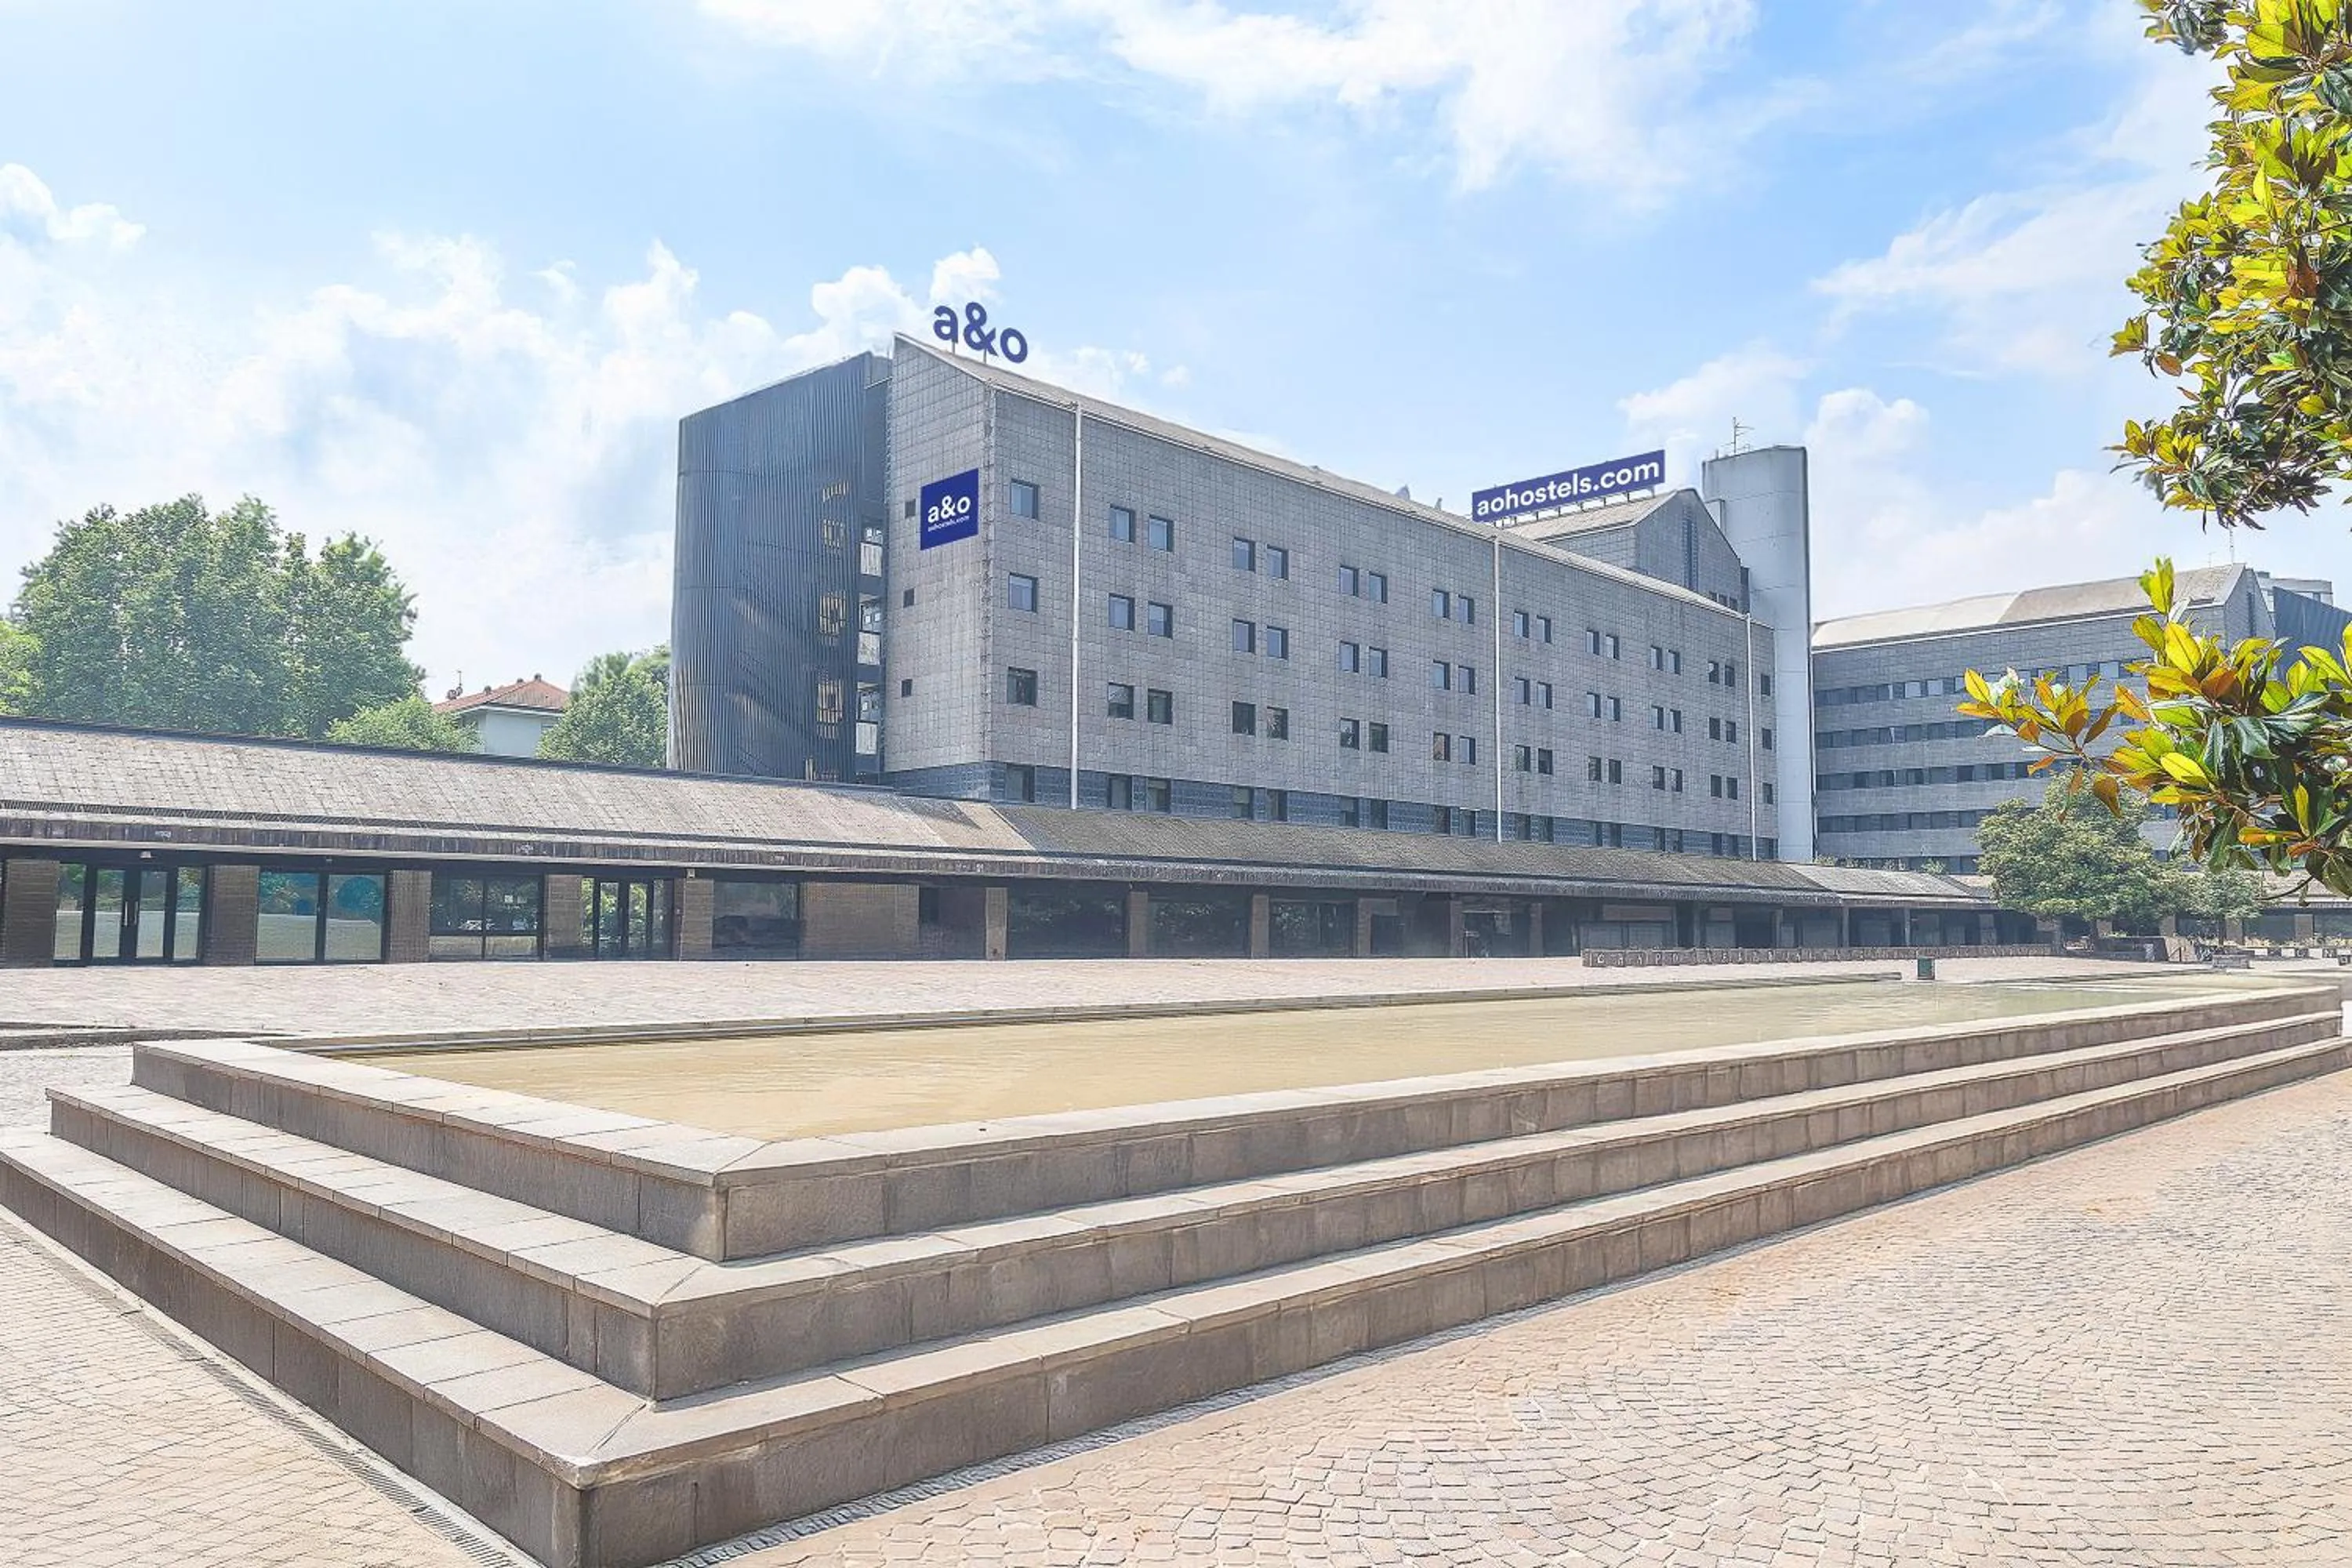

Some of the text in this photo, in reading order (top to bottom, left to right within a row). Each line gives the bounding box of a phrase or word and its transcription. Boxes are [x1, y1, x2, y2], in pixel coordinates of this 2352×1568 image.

[933, 302, 1028, 364] a&o
[927, 495, 971, 523] a&o
[1477, 461, 1660, 515] aohostels.com
